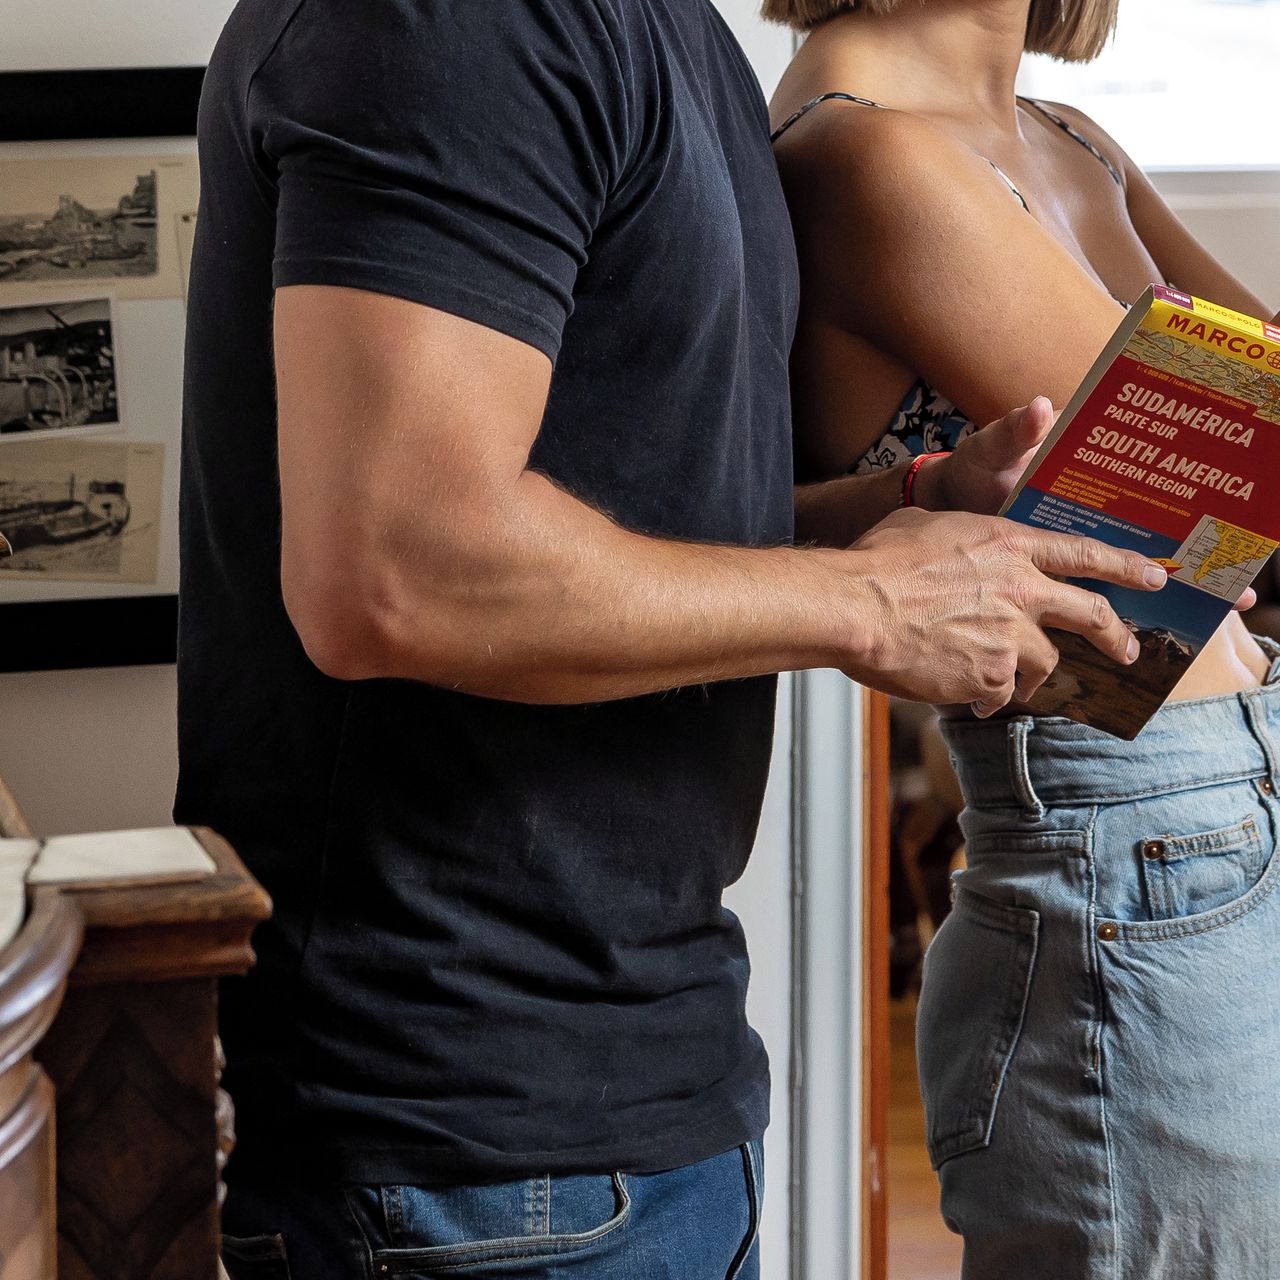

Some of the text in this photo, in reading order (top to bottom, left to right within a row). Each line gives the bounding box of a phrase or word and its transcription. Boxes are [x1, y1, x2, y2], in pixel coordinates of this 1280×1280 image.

[1166, 313, 1265, 359] MARCO
[1104, 404, 1178, 440] PARTE SUR
[1117, 383, 1255, 448] SUDAMÉRICA
[1074, 447, 1198, 500] SOUTHERN REGION
[1086, 426, 1254, 501] SOUTH AMERICA
[1041, 495, 1057, 504] With
[1092, 513, 1105, 521] and
